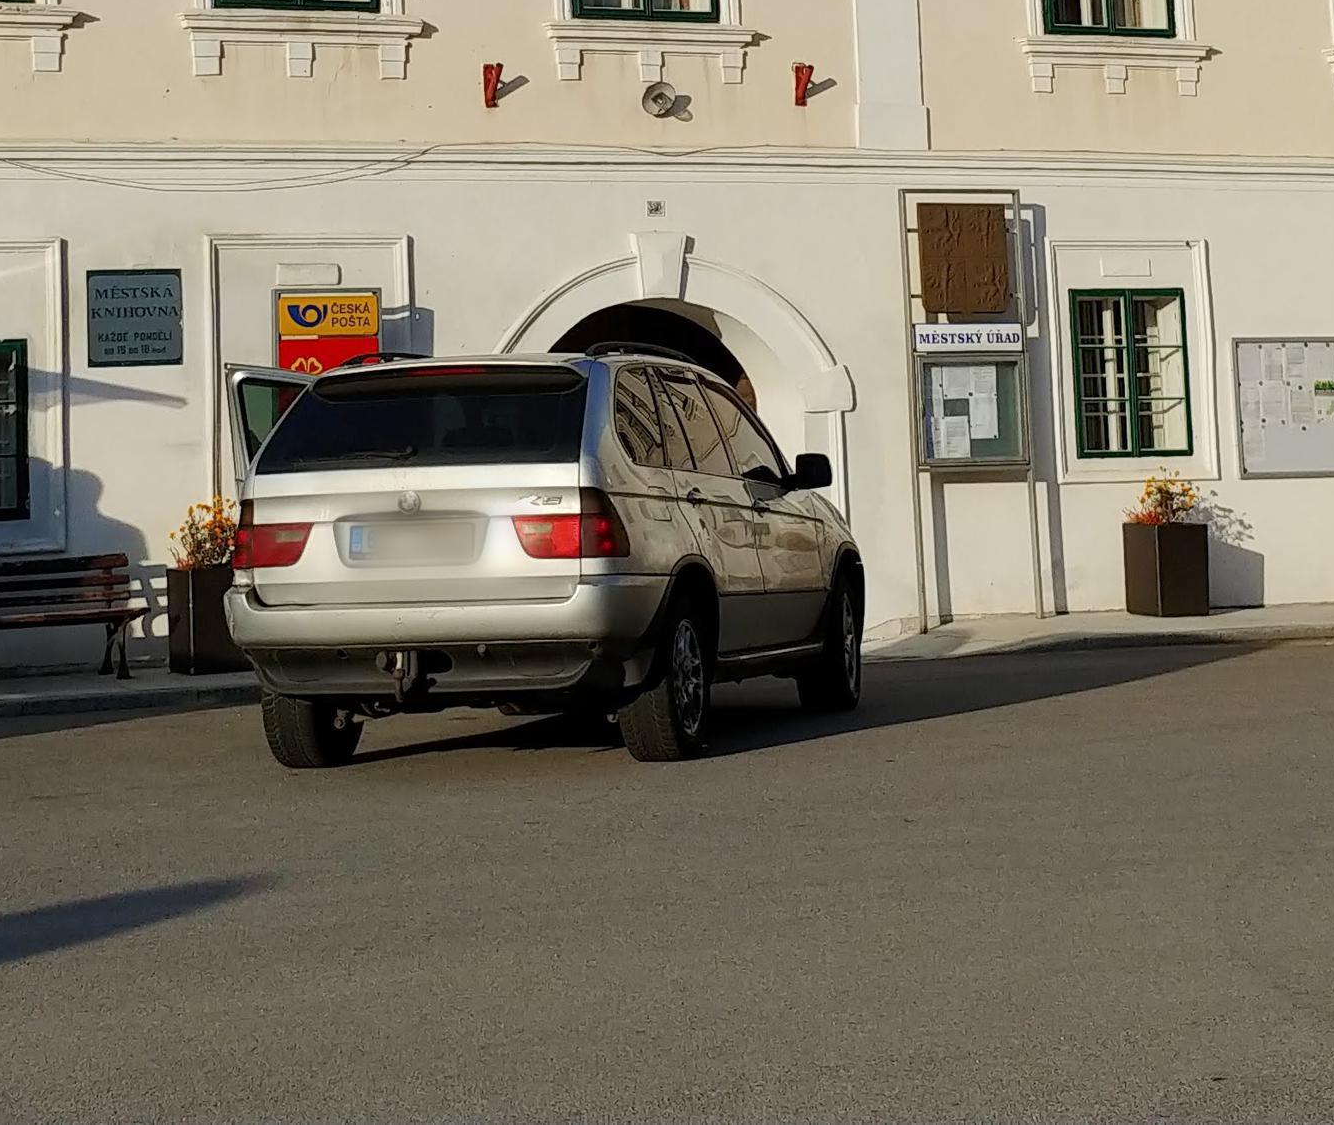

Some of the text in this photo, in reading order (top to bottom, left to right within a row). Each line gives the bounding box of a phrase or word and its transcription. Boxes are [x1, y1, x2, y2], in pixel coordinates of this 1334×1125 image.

[91, 305, 180, 319] KNIHOVNA
[331, 302, 371, 314] ČESKÁ
[331, 315, 371, 327] POŠTA
[919, 329, 1020, 344] MĚSTSKÝ ÚŘAD
